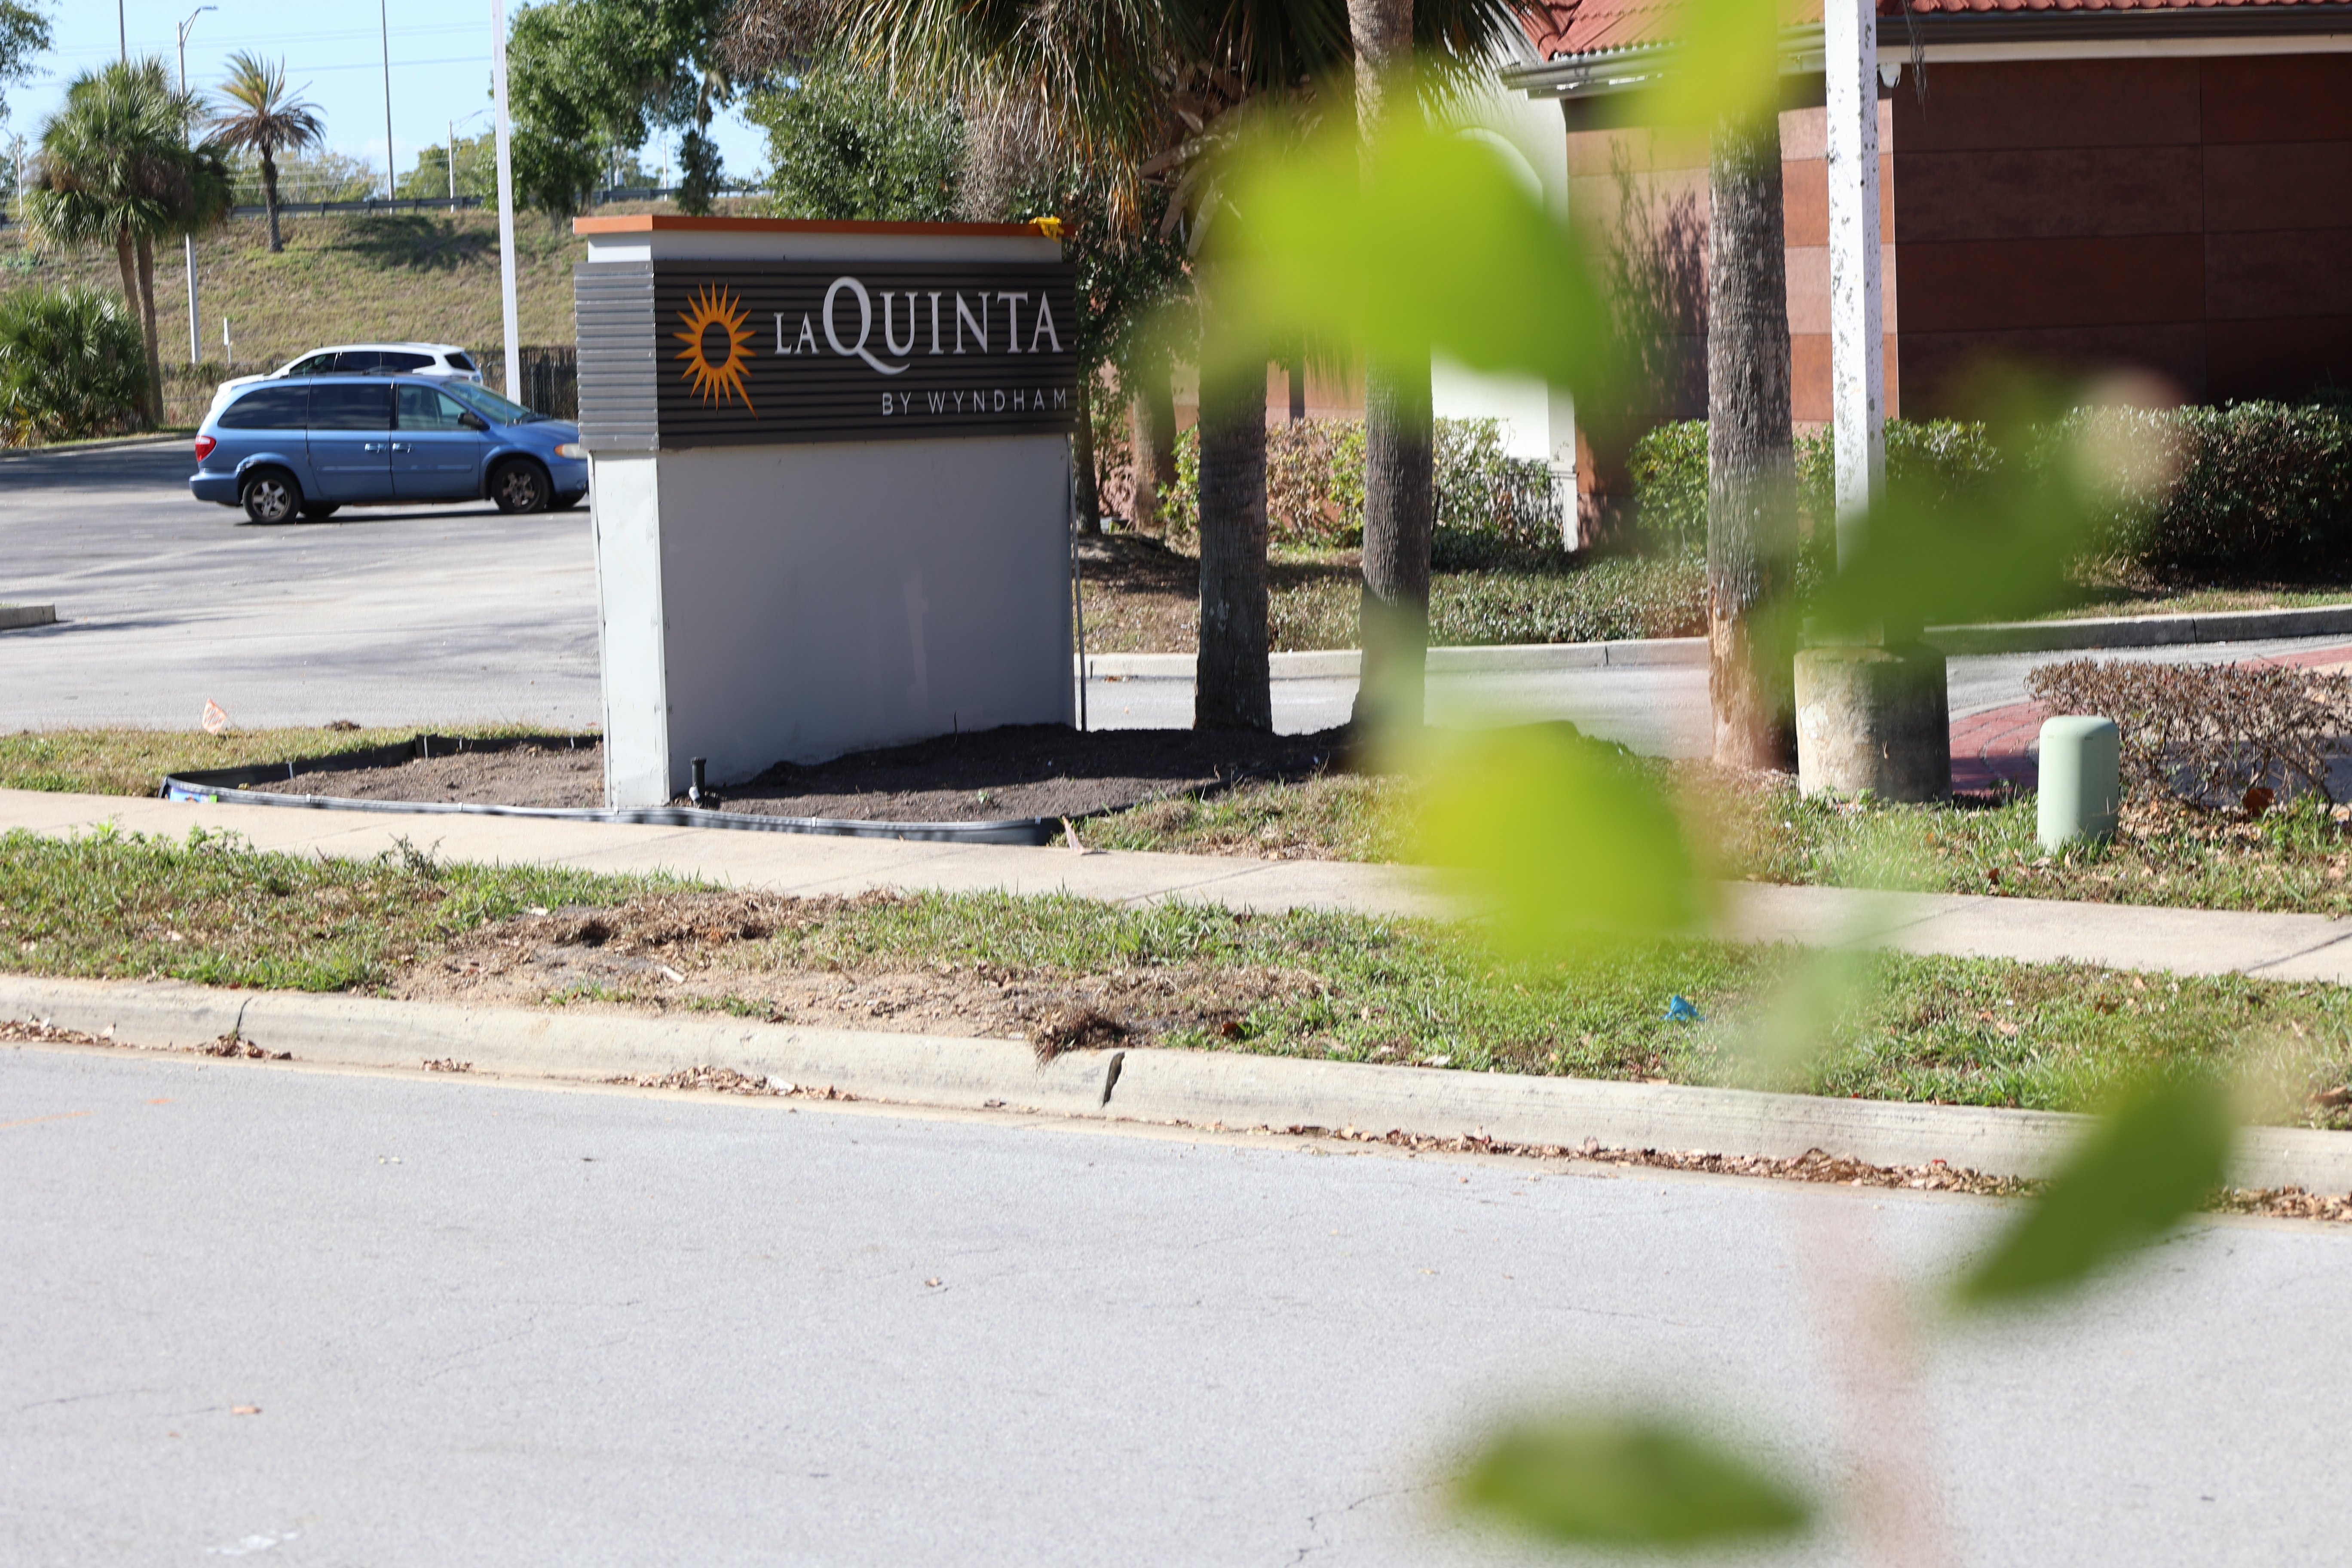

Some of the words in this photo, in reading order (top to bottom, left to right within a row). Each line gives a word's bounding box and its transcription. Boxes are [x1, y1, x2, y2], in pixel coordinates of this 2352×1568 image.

[774, 311, 820, 355] LA
[822, 276, 1063, 375] QUINTA
[882, 392, 911, 416] BY
[928, 387, 1066, 413] WYNDHAM
